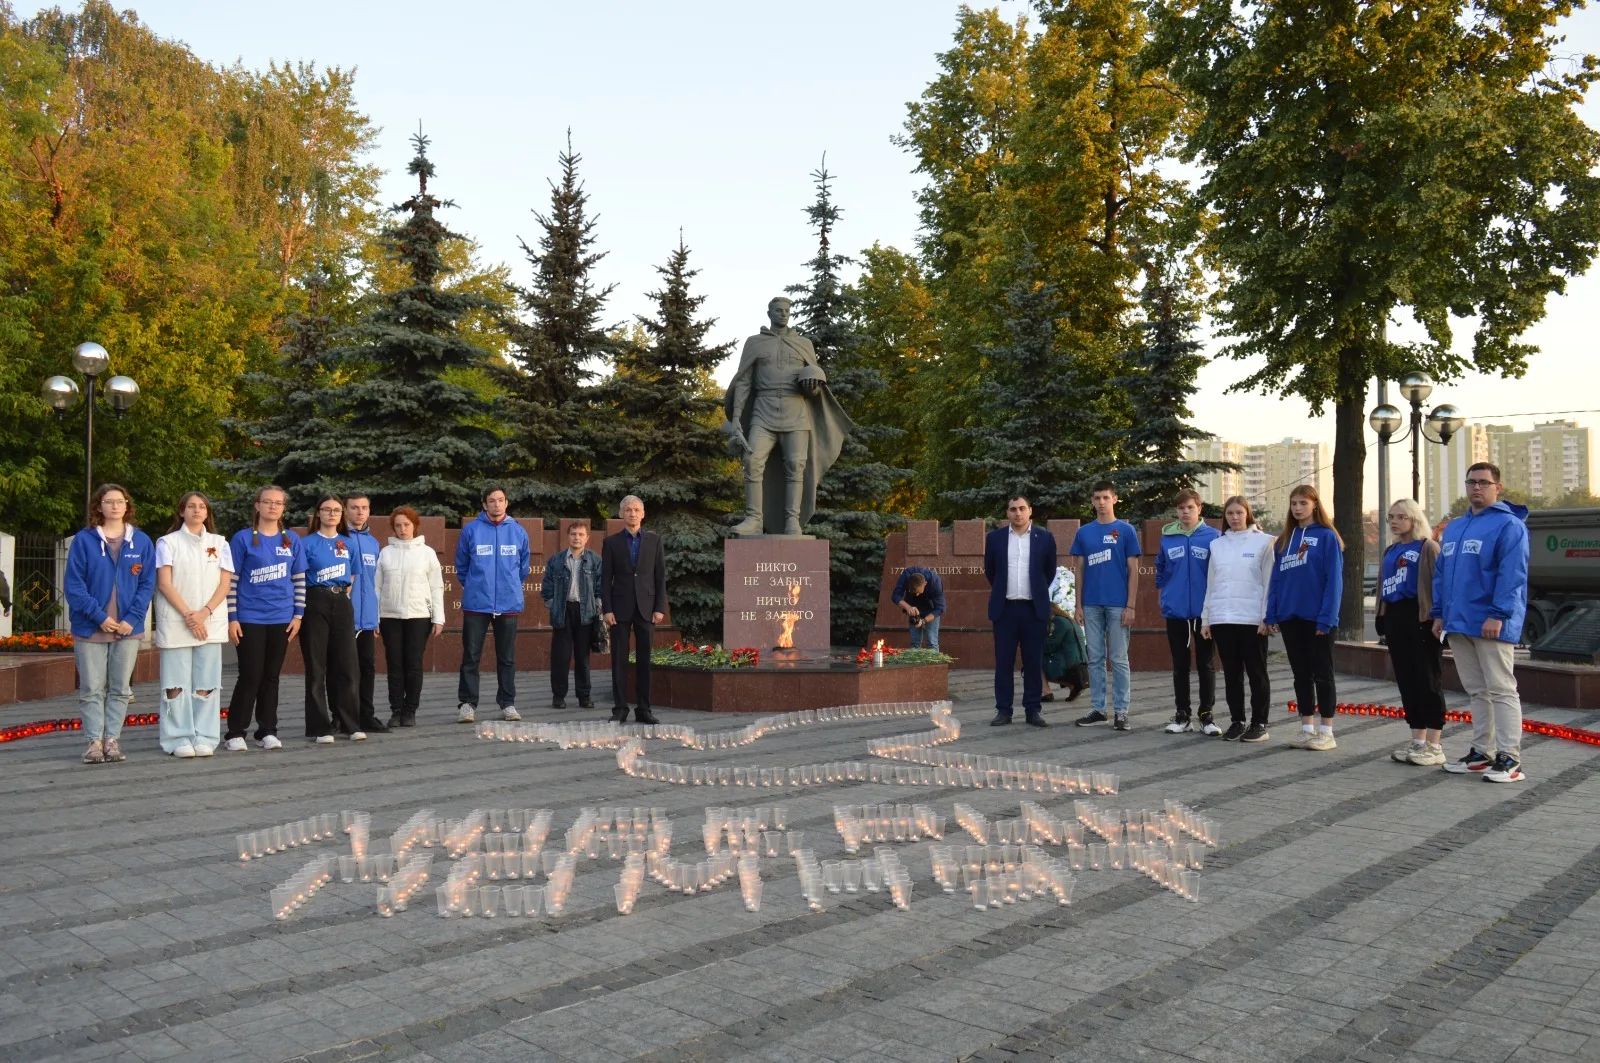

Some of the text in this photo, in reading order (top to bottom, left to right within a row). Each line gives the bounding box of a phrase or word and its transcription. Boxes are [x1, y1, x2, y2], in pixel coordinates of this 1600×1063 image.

[756, 562, 797, 572] НИКТО
[744, 576, 812, 587] НЕ ЗАБЫТ,
[756, 596, 797, 606] НИЧТО
[741, 611, 757, 621] НЕ
